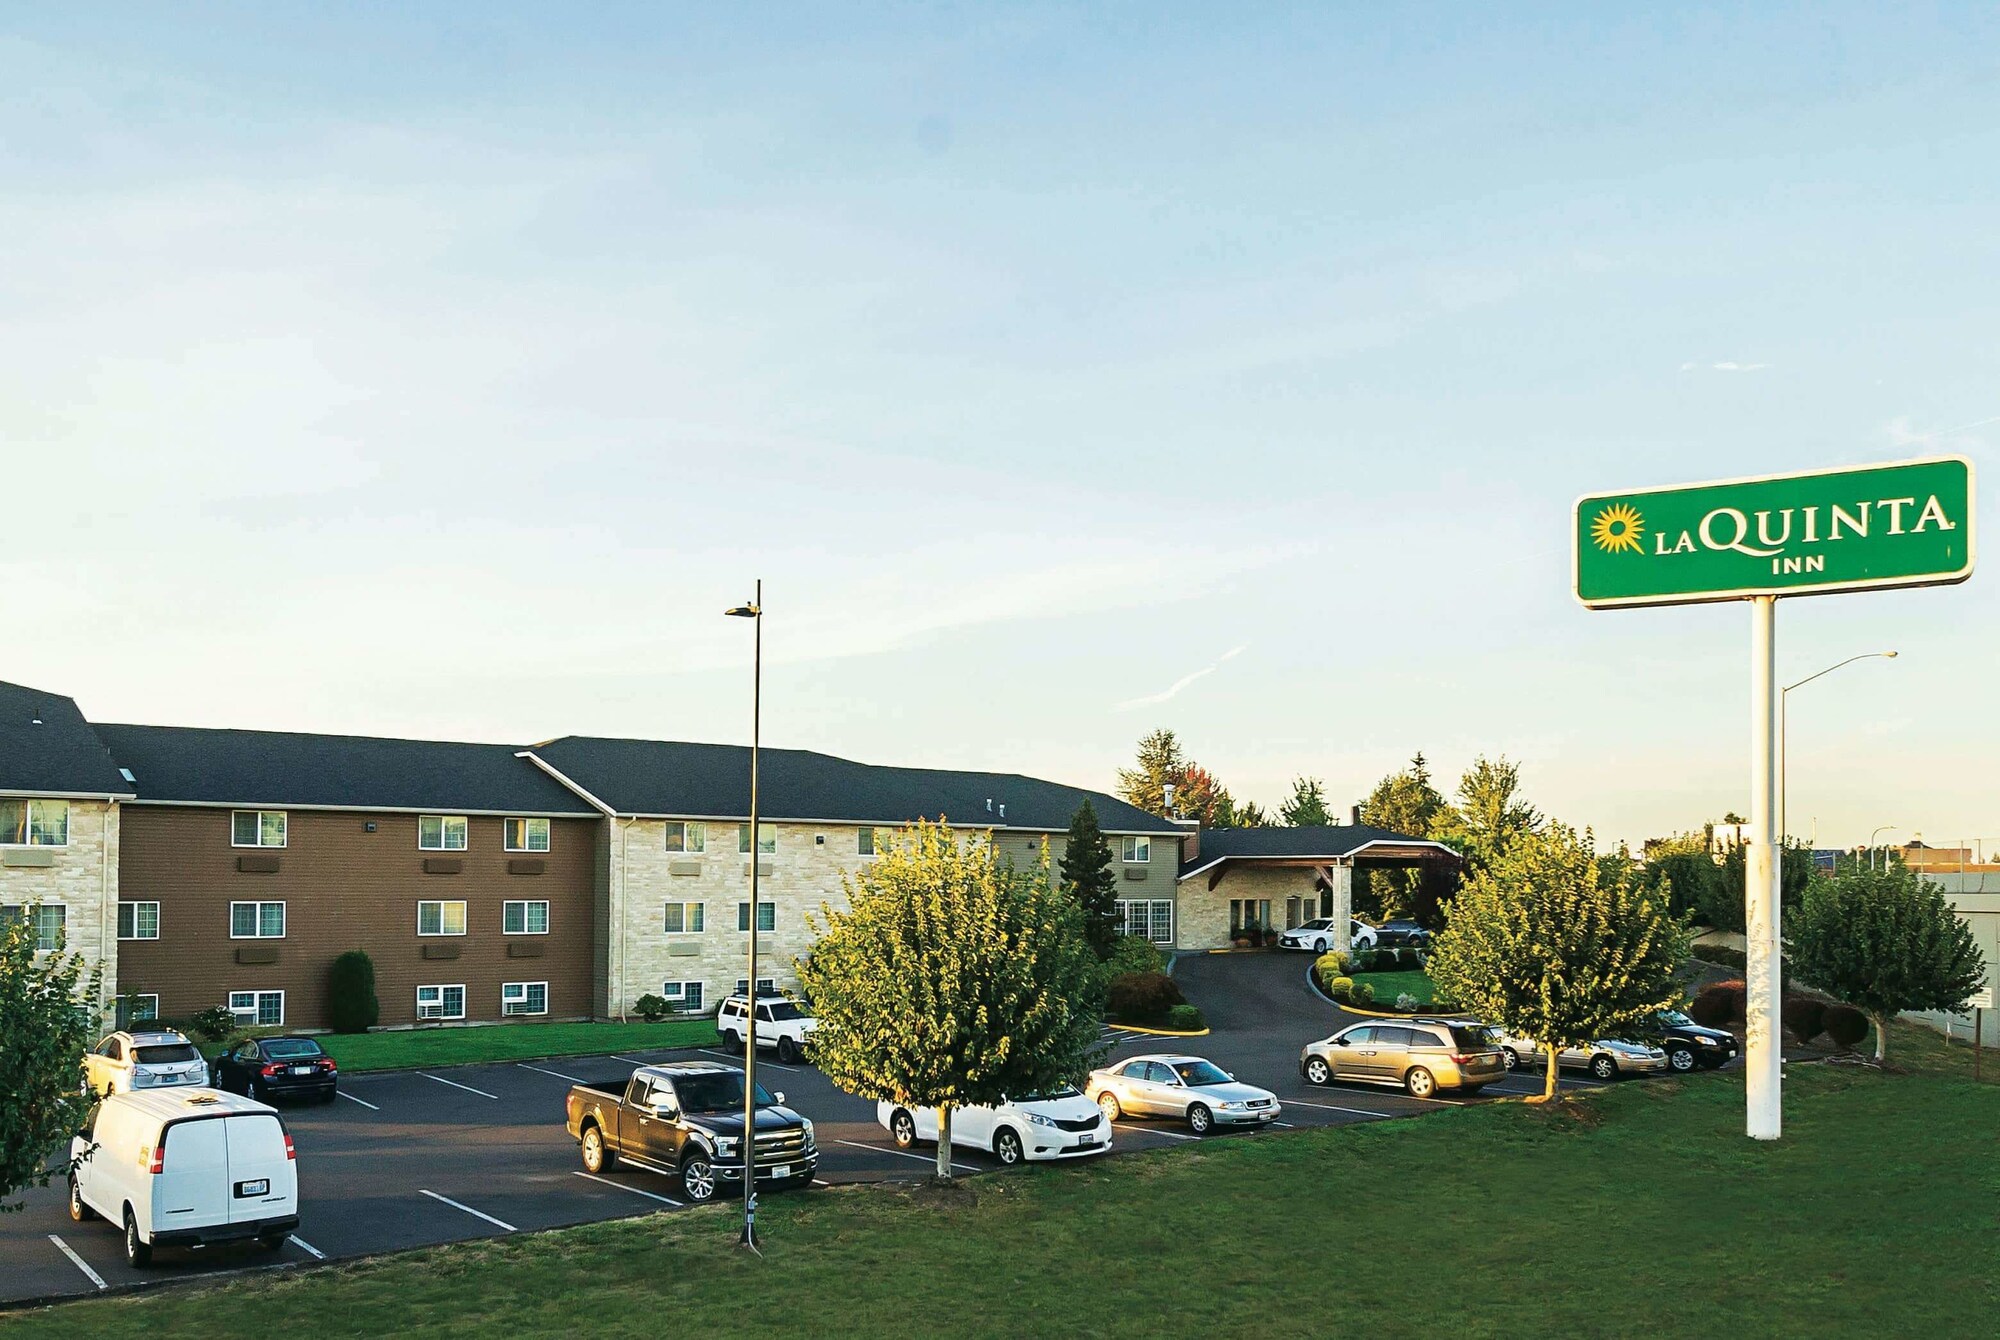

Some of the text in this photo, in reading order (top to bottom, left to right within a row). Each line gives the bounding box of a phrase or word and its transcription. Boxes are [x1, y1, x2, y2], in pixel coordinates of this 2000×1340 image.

[1655, 494, 1954, 557] LA QUINTA
[1772, 555, 1824, 575] INN
